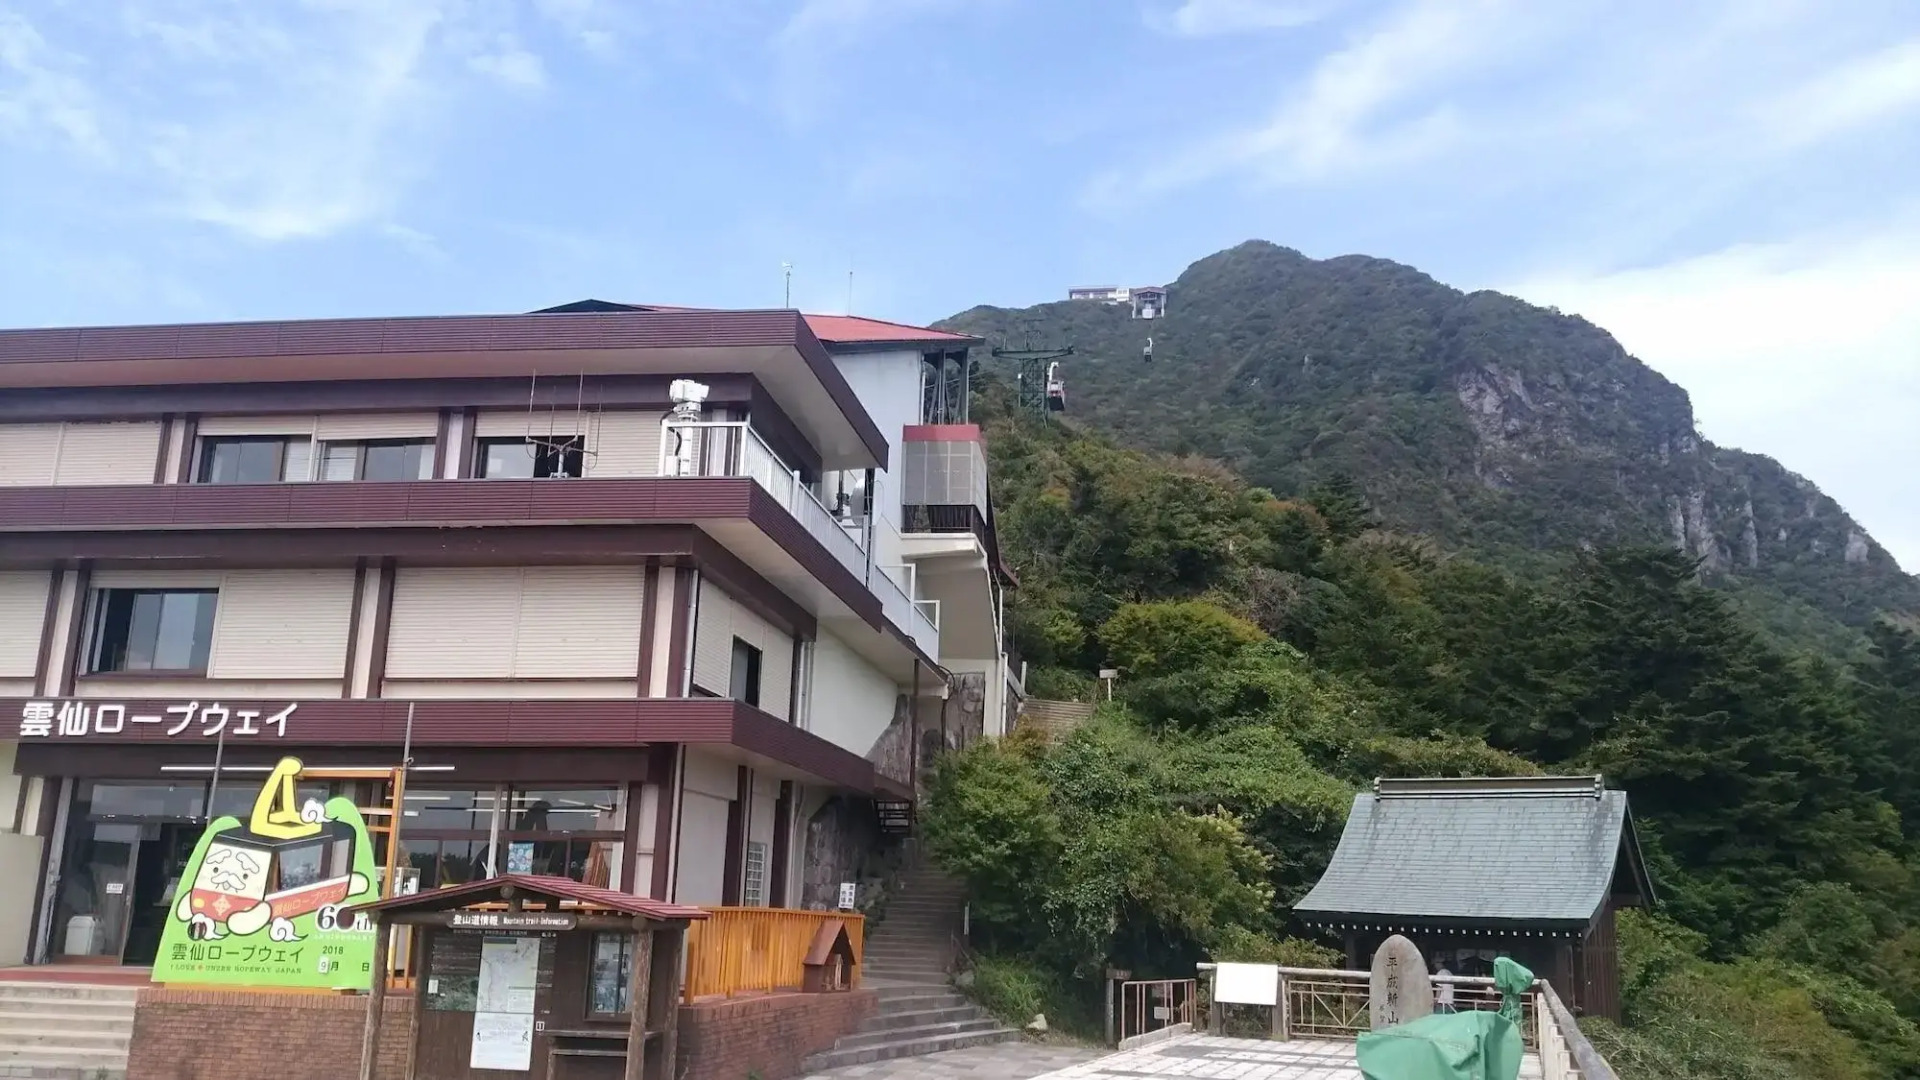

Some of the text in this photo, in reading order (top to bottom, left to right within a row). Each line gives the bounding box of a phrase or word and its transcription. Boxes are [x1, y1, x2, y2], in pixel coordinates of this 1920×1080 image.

[20, 701, 298, 737] 雲仙ロープウェイ
[453, 914, 499, 926] 登山道情報
[503, 916, 524, 925] Mountain
[171, 943, 305, 963] 雲仙ロープウェイ
[322, 945, 344, 956] 2018
[234, 965, 271, 973] ROPEWAY
[275, 967, 302, 975] JAPAN
